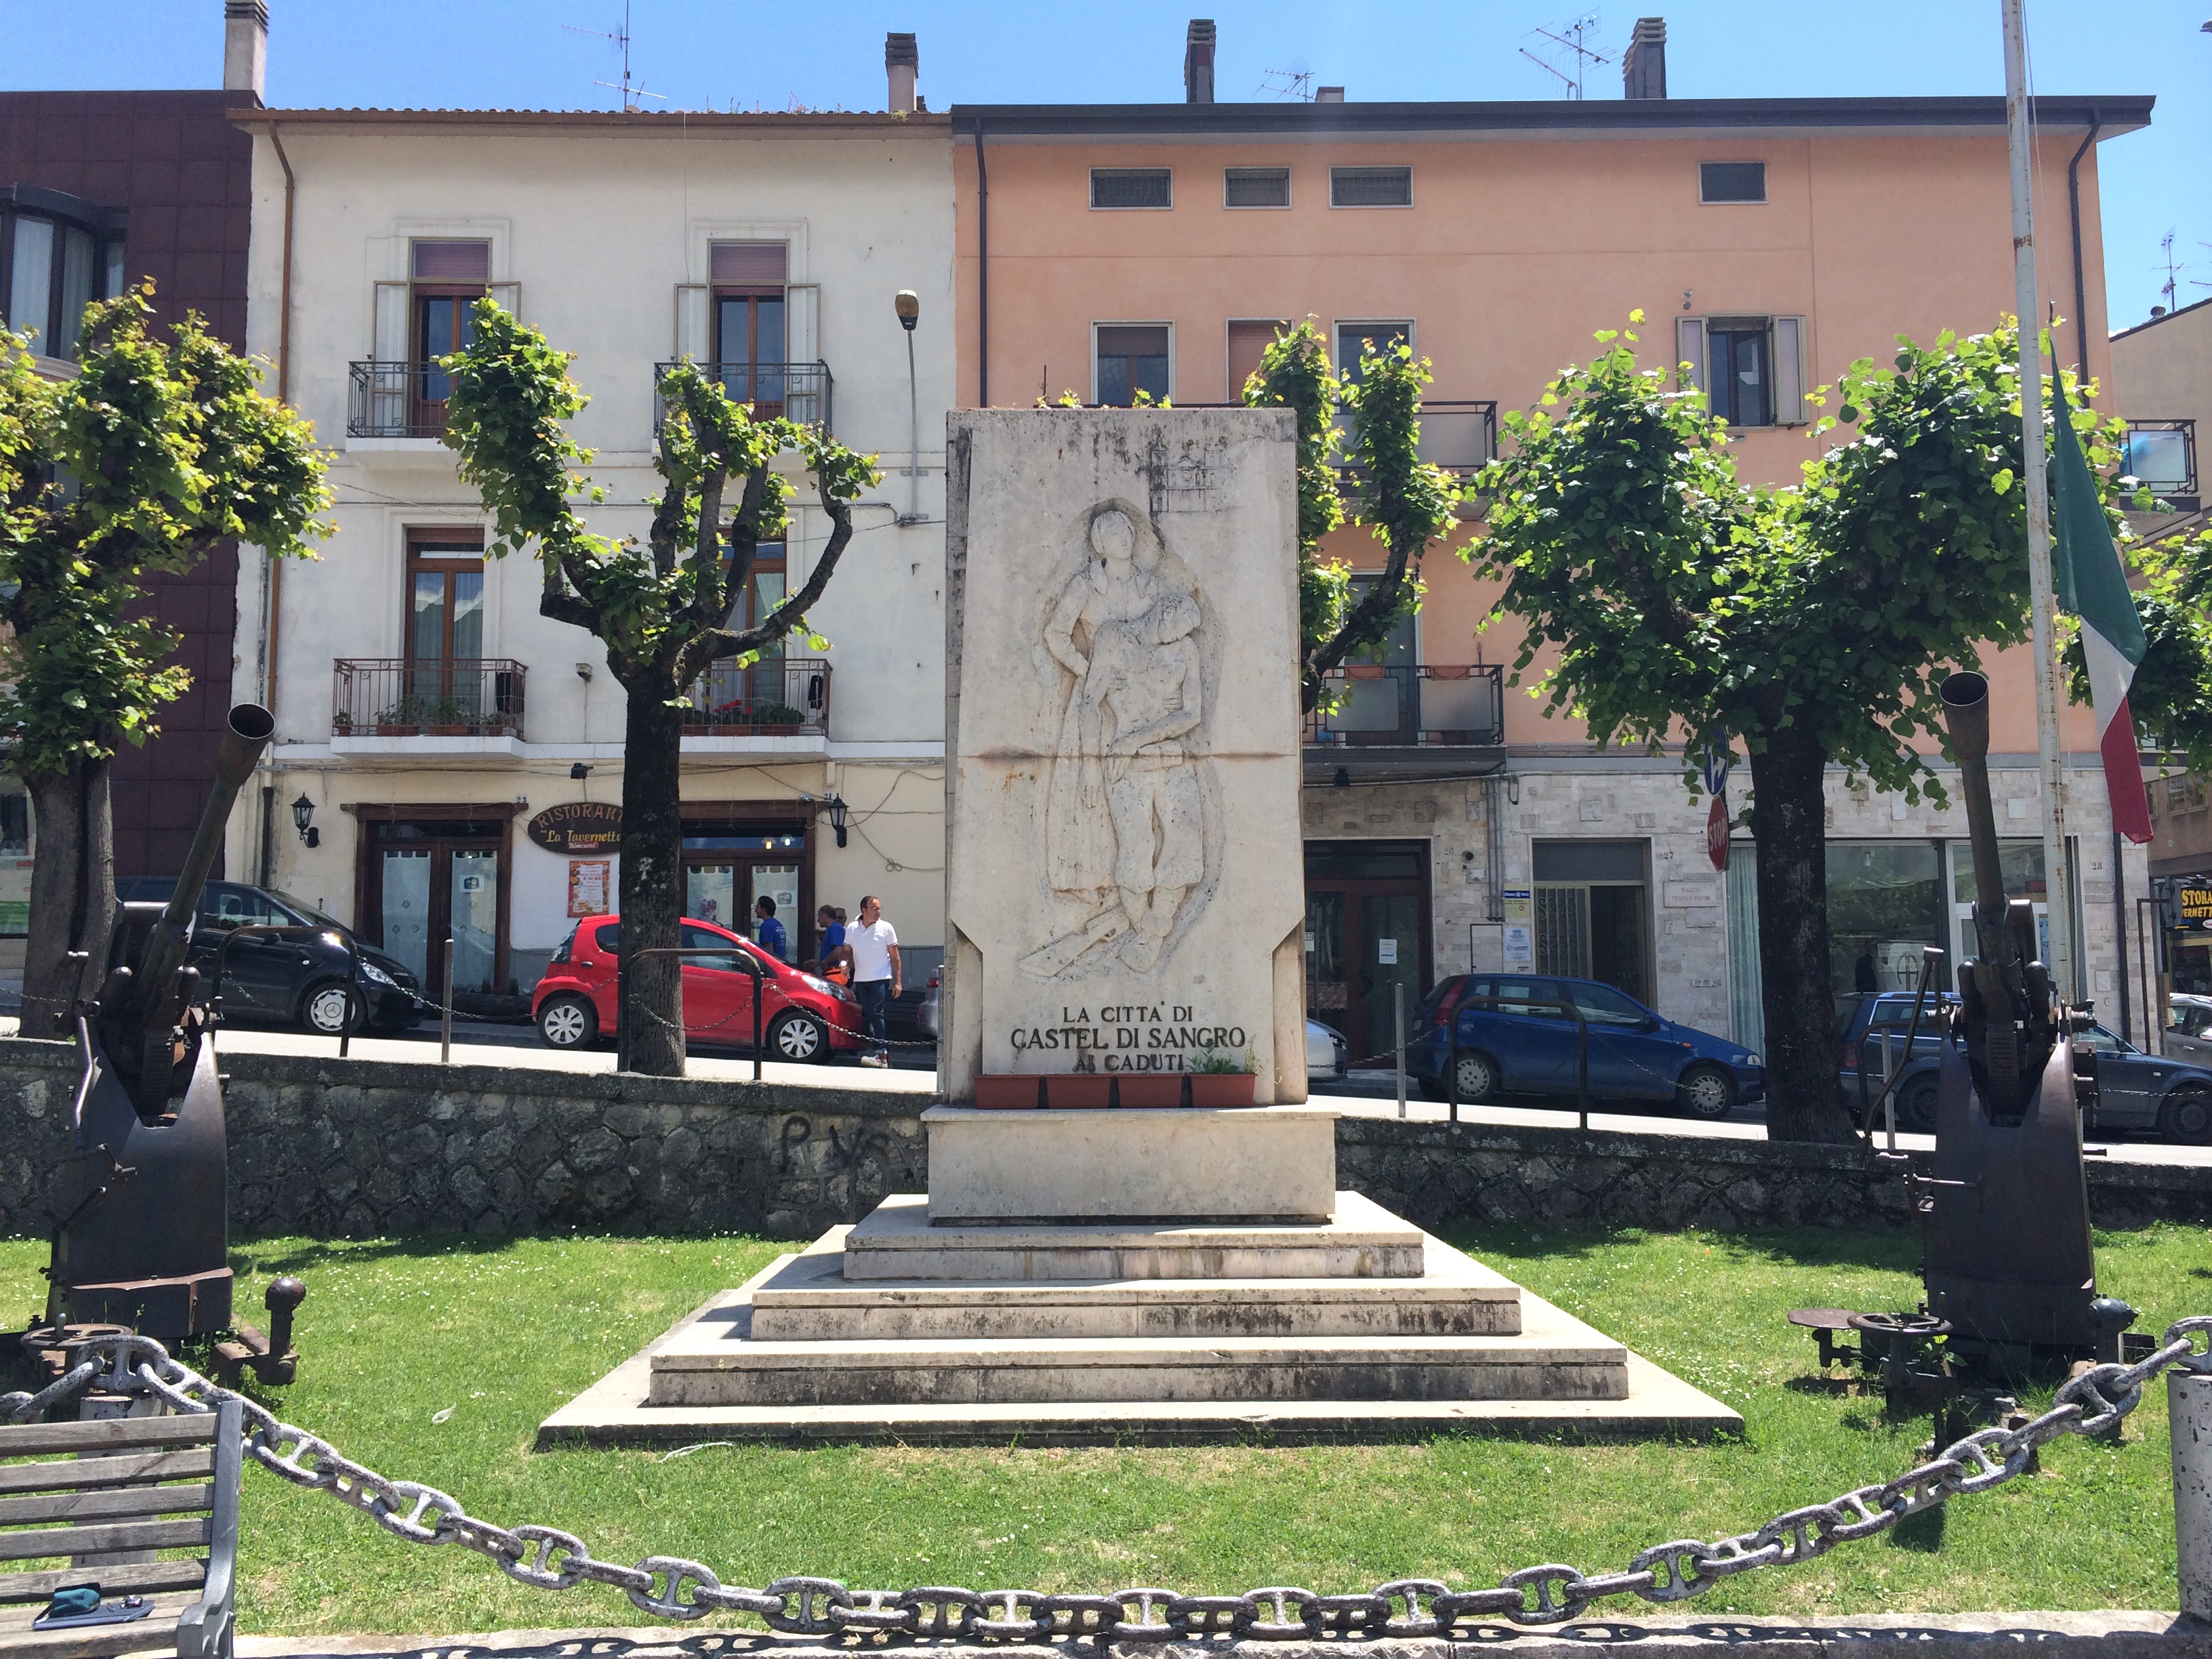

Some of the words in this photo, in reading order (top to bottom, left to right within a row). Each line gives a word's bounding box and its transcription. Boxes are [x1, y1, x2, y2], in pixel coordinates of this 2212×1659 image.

[516, 796, 527, 804] 23
[823, 792, 832, 800] 21
[1708, 817, 1726, 852] STOP
[1663, 851, 1674, 859] 27
[2182, 906, 2212, 918] ERNETT
[1063, 1006, 1090, 1023] LA
[1173, 1006, 1193, 1022] DI
[1010, 1027, 1109, 1050] CASTEL
[1116, 1027, 1139, 1048] DI
[1147, 1026, 1246, 1049] SANGRO
[1104, 1054, 1184, 1071] CADUTI
